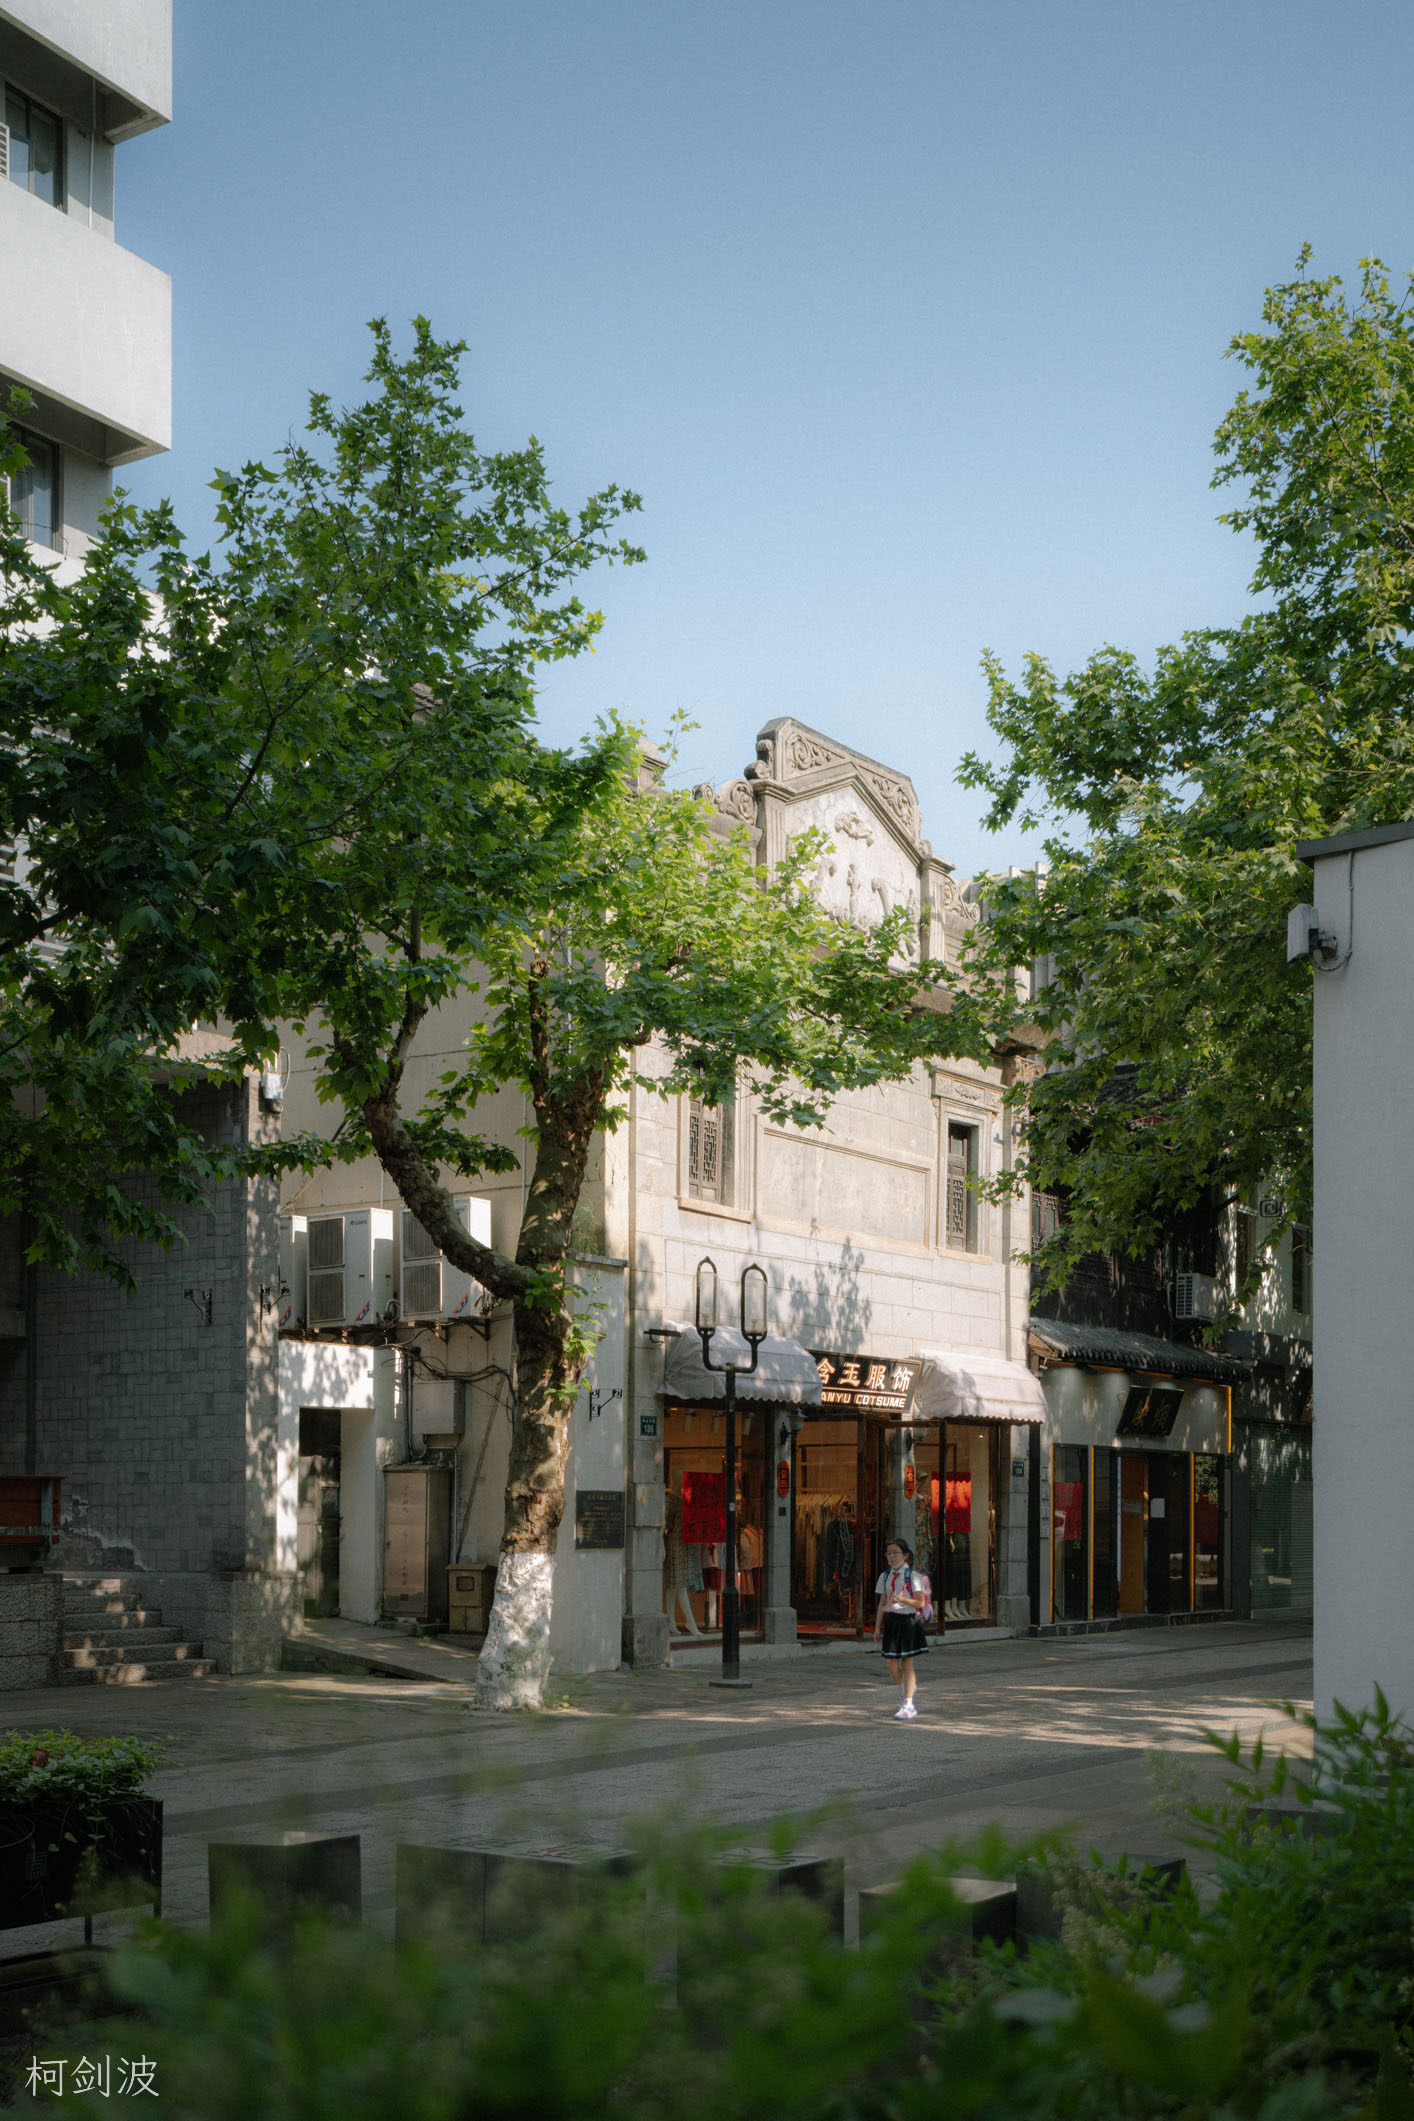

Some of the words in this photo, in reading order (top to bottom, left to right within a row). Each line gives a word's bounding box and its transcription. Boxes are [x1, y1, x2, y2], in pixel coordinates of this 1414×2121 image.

[816, 1357, 914, 1392] 含玉服饰
[821, 1391, 852, 1403] ANYU
[855, 1394, 907, 1408] COTSUME
